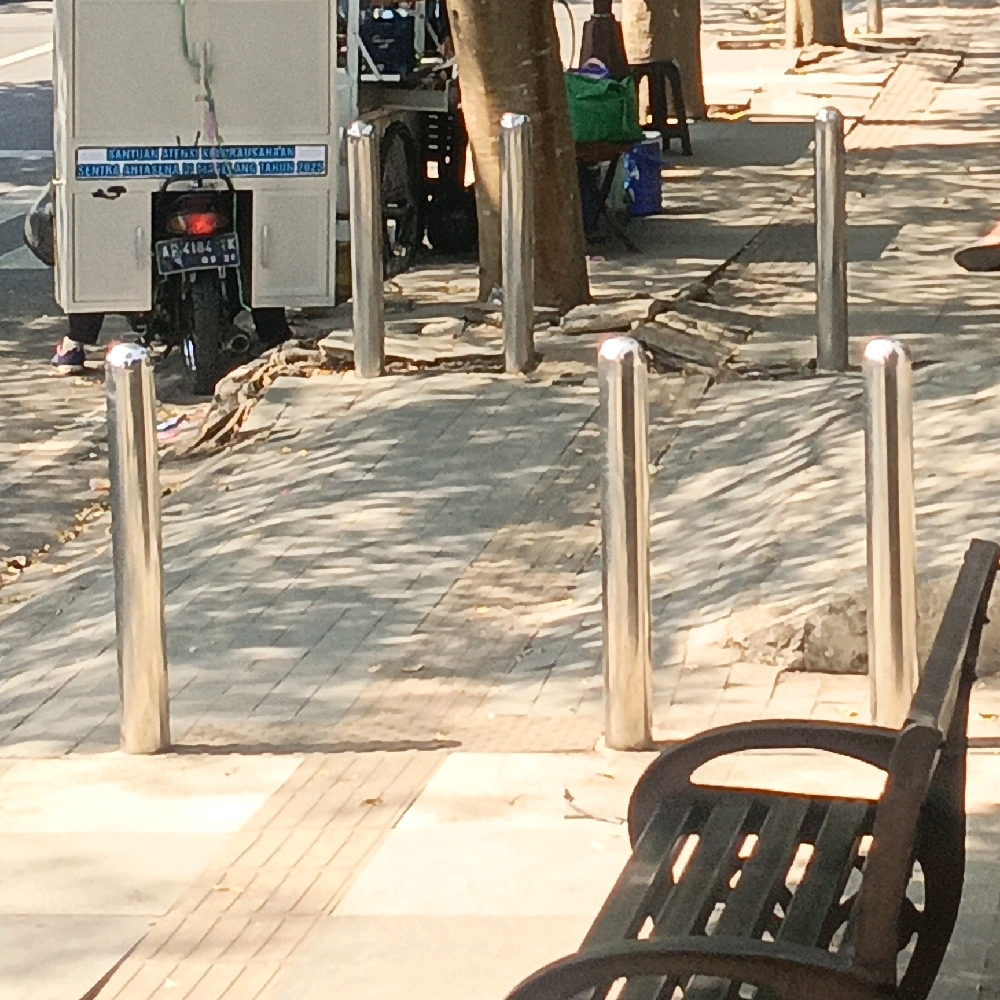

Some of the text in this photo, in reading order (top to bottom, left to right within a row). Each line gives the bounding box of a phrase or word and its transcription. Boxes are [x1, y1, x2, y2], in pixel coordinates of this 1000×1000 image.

[108, 148, 158, 160] BANTUAN
[78, 164, 118, 176] SENTRA
[259, 162, 294, 173] TAHUN
